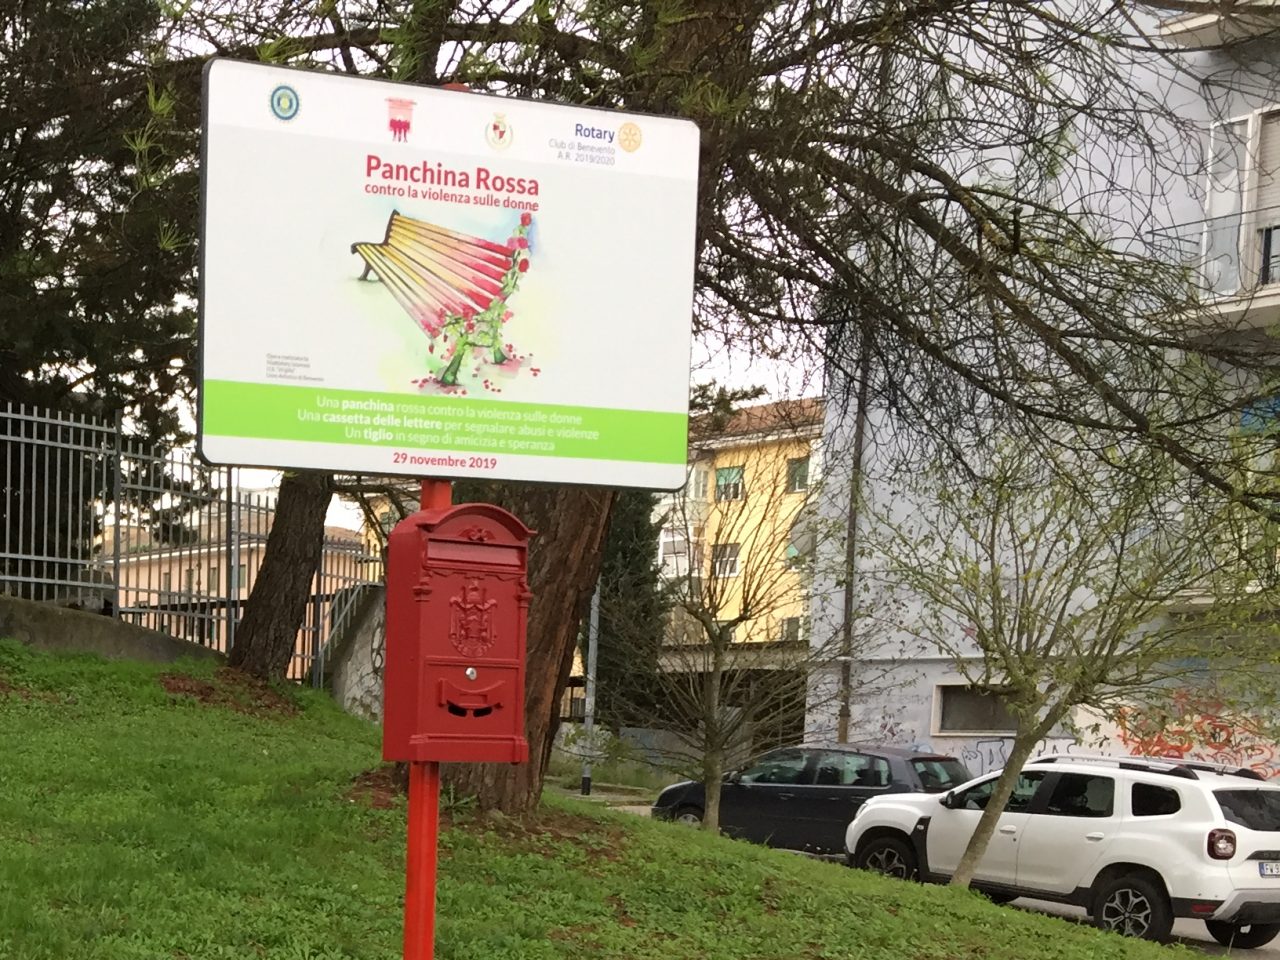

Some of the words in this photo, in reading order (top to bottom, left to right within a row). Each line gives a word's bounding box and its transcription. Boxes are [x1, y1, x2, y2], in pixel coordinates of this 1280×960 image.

[548, 138, 566, 149] Club
[568, 141, 575, 150] di
[575, 123, 615, 143] Rotary
[366, 154, 470, 189] Panchina
[476, 167, 539, 196] Rossa
[365, 182, 405, 197] contro
[407, 186, 418, 199] la
[421, 187, 471, 204] violenza
[473, 194, 500, 208] sulle
[503, 196, 540, 211] donne
[317, 395, 340, 408] Una
[342, 398, 395, 412] panchina
[396, 403, 426, 415] rossa
[427, 404, 464, 417] contro
[465, 406, 476, 418] la
[477, 407, 521, 421] violenza
[523, 410, 547, 423] sulle
[549, 412, 583, 425] donne
[297, 408, 321, 422] Una
[322, 412, 371, 426] cassetta
[373, 414, 401, 427] delle
[403, 416, 443, 430] lettere
[444, 421, 462, 433] per
[464, 422, 517, 436] segnalare
[518, 425, 545, 436] abusi
[547, 428, 554, 437] e
[556, 427, 600, 440] violenze
[345, 426, 361, 438] Un
[363, 428, 394, 442] tiglio
[395, 431, 406, 441] in
[407, 432, 440, 445] segno
[441, 433, 452, 445] di
[454, 435, 497, 448] amicizia
[499, 438, 506, 447] e
[508, 438, 556, 452] speranza
[393, 452, 408, 464] 29
[410, 454, 466, 468] novembre
[469, 456, 497, 469] 2019
